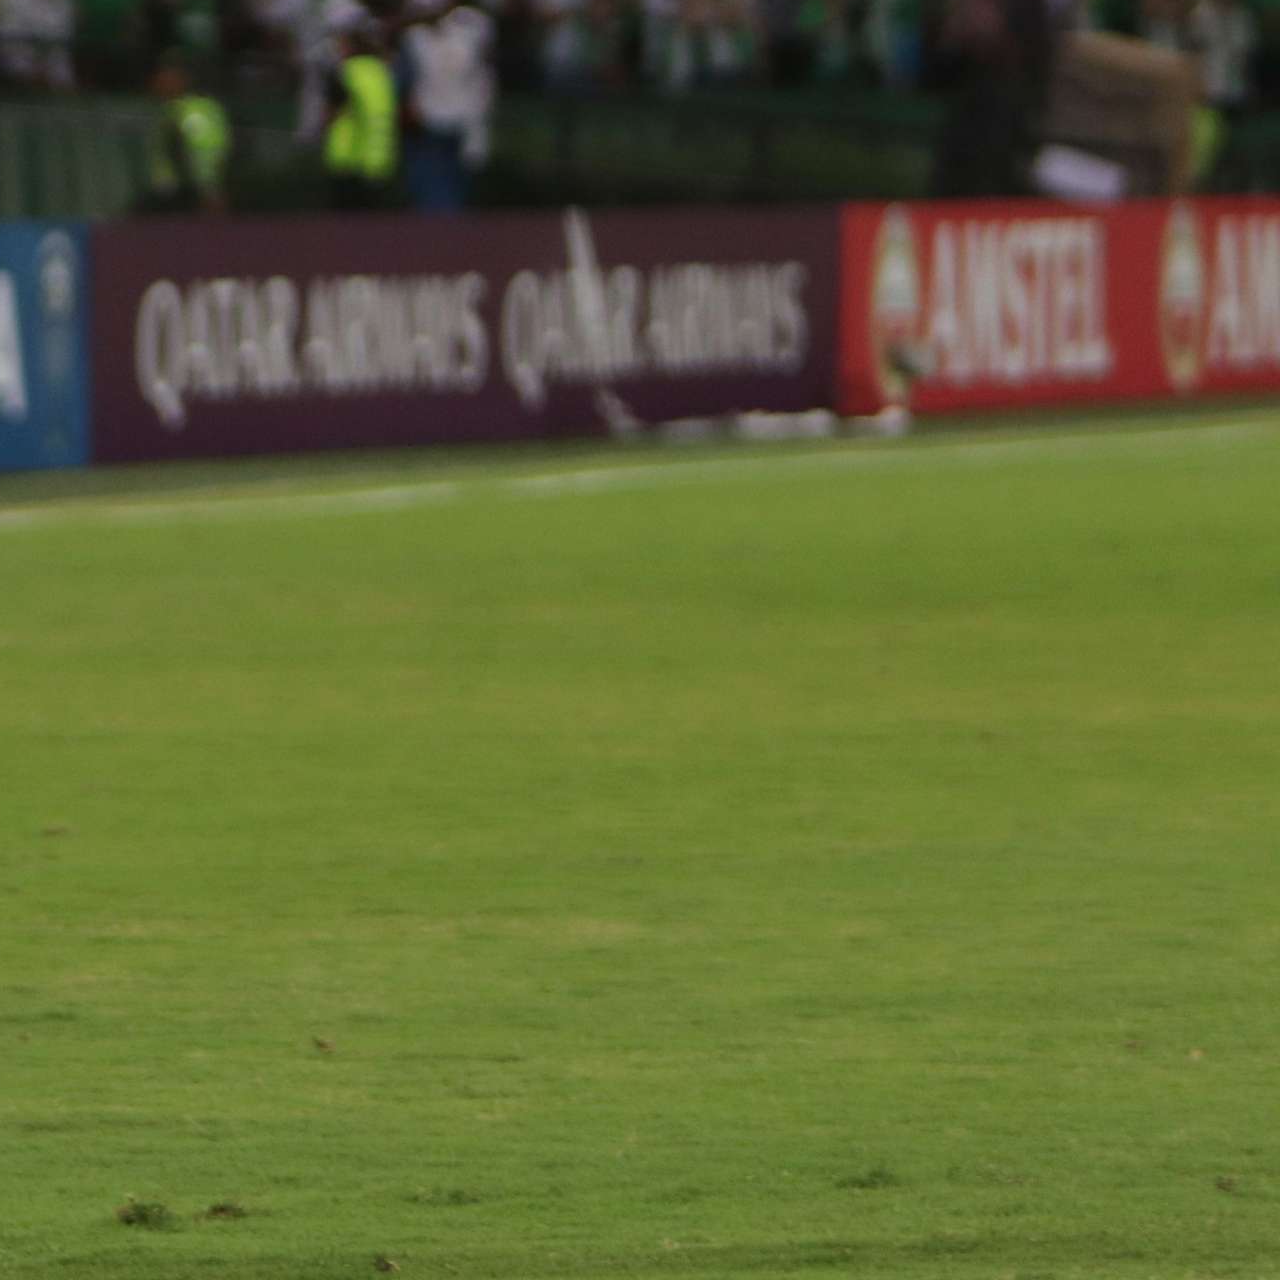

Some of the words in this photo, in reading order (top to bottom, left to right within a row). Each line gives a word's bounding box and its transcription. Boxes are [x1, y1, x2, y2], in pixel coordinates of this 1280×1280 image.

[135, 277, 299, 430] QATAR
[303, 273, 489, 395] AIRWAYS
[930, 218, 1114, 386] AMSTEL
